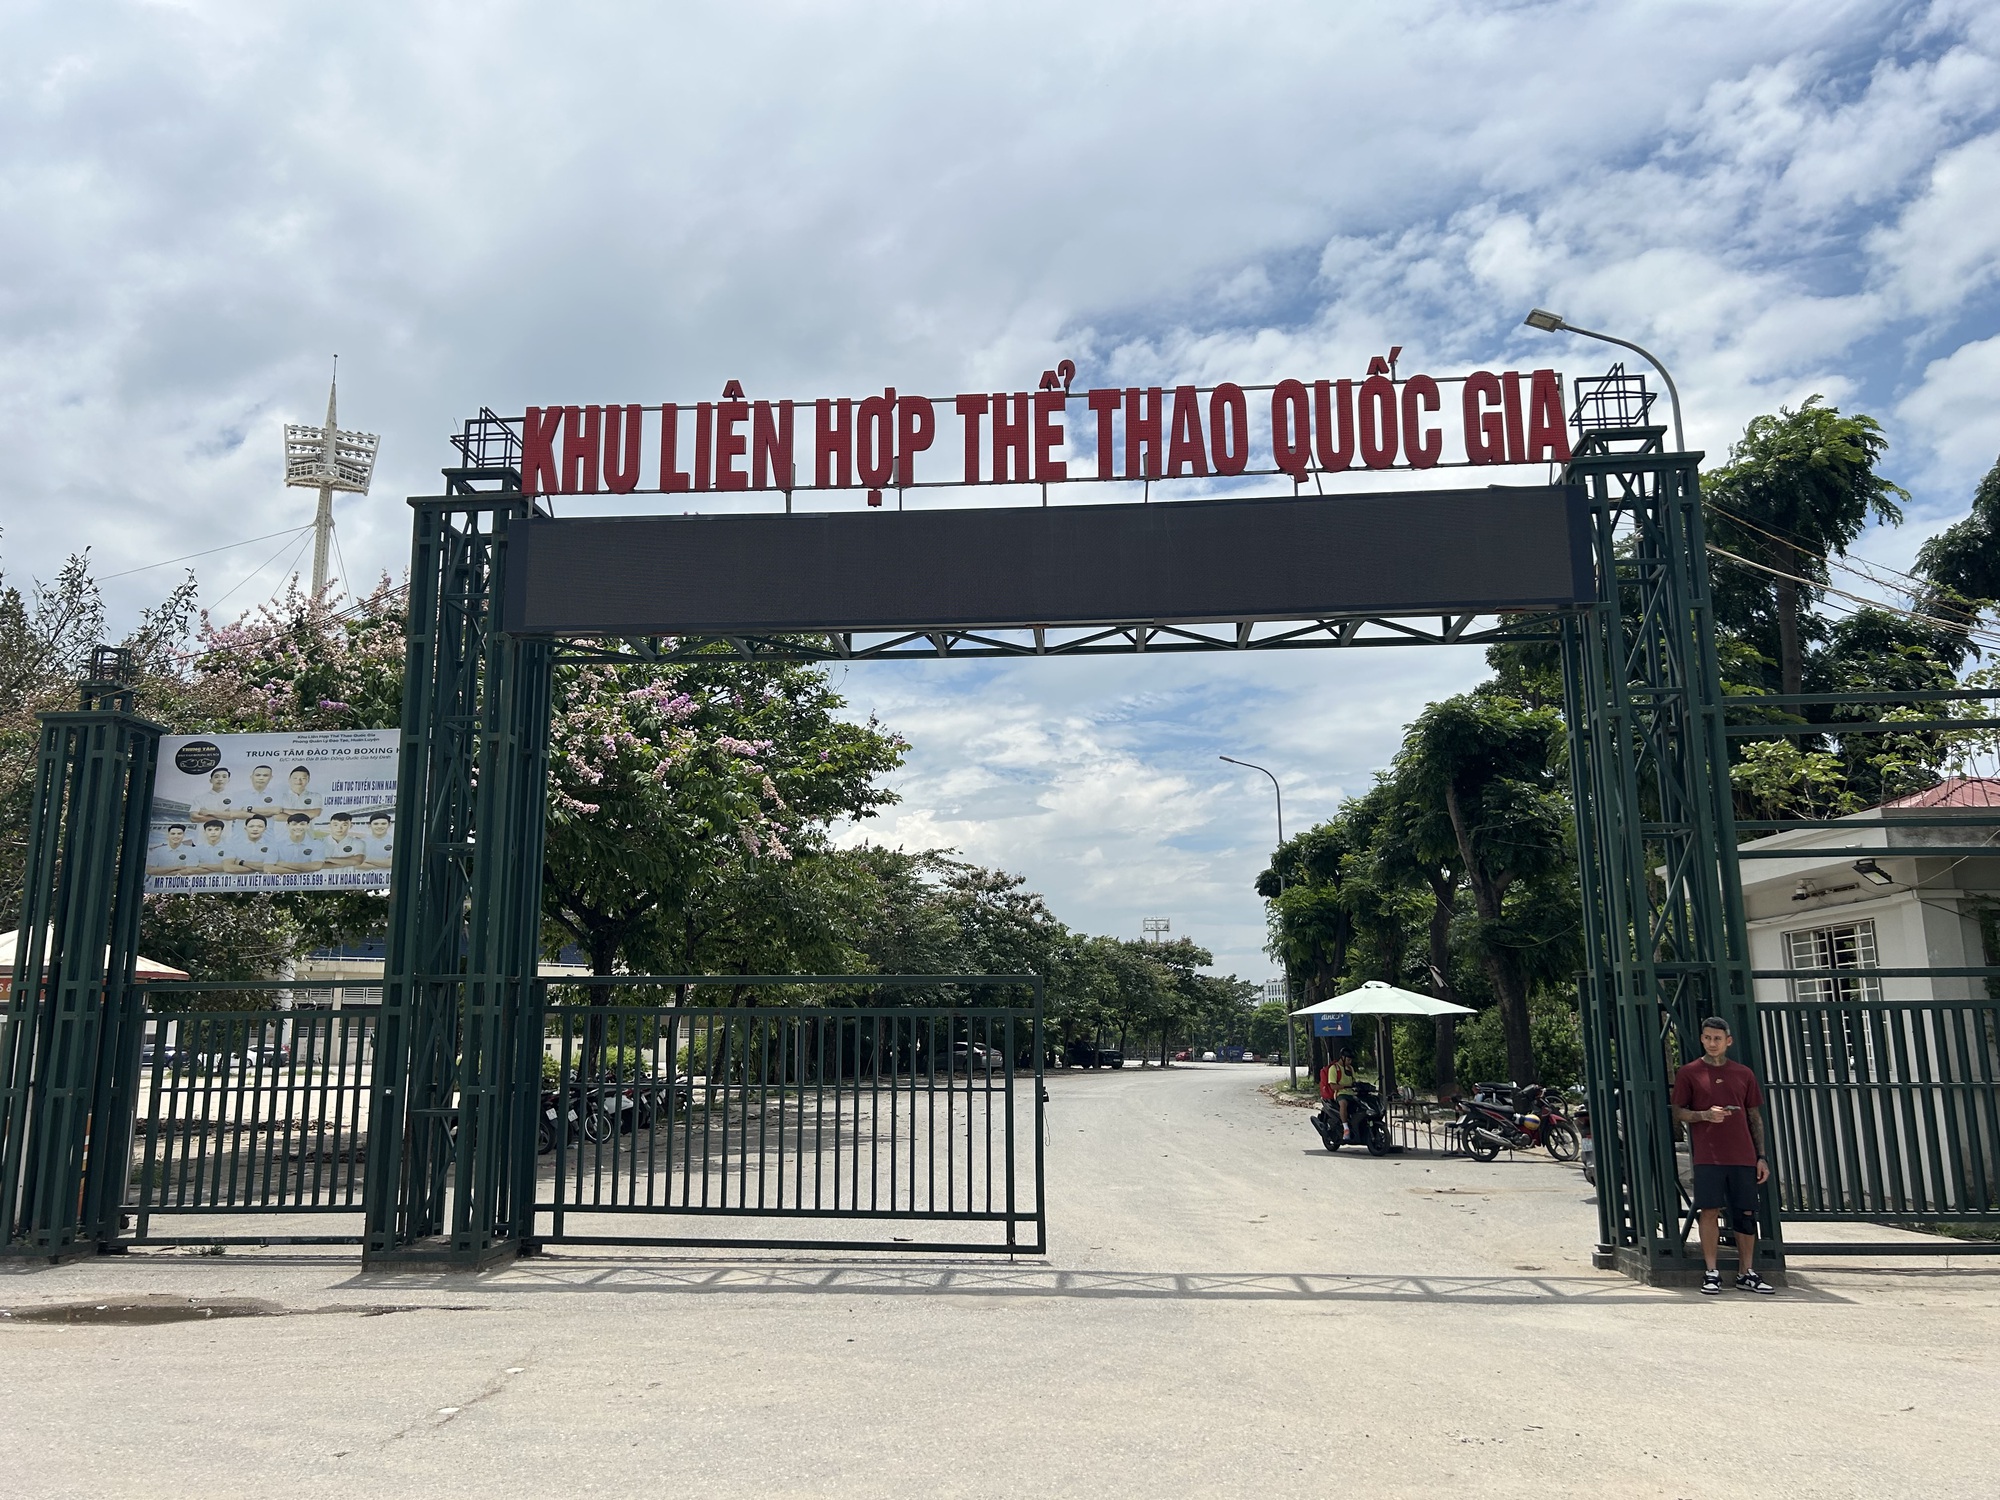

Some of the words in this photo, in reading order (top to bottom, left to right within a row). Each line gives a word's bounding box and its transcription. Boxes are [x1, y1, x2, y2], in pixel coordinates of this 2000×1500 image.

[521, 404, 643, 495] KHU
[659, 379, 794, 492] LIÊN
[815, 386, 935, 507] HỢP
[956, 359, 1076, 485] THỂ
[1088, 381, 1250, 481] THAO
[1271, 346, 1442, 483] QUỐC
[1463, 368, 1572, 465] GIA
[154, 876, 164, 888] MR
[192, 876, 232, 887] 0968.166.101
[237, 875, 249, 887] HLV
[282, 874, 323, 886] 0968.156.699
[328, 874, 340, 885] HLV
